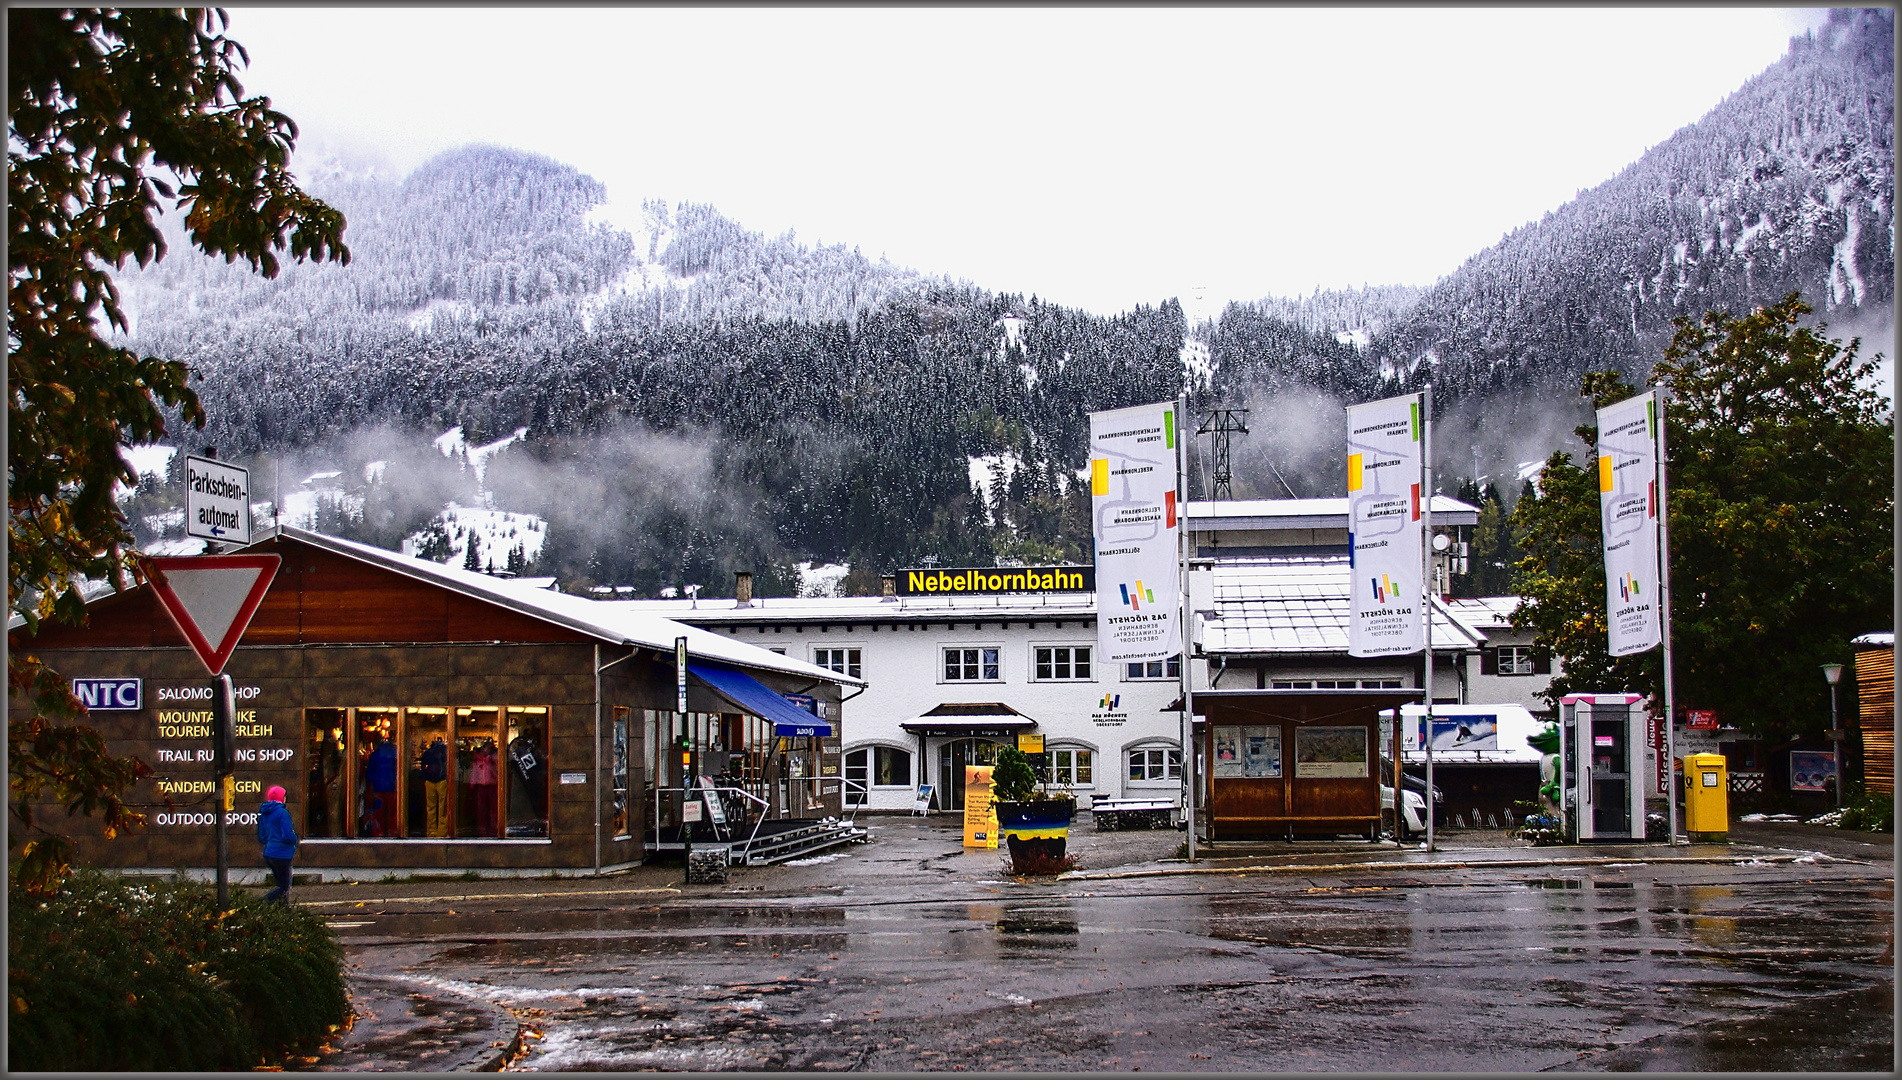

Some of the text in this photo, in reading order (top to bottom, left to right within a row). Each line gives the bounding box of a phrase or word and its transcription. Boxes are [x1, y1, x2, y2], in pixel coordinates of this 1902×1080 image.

[190, 468, 246, 500] Parkschein-
[200, 505, 239, 529] automat
[908, 568, 1083, 592] Nebelhornbahn
[77, 683, 136, 706] NTC
[158, 687, 261, 700] SALOMO HOP
[159, 725, 273, 737] TOUREN ERLEIH
[1648, 719, 1656, 746] Neue
[158, 749, 294, 761] TRAIL RUNG SHOP
[157, 813, 217, 825] OUTDOO
